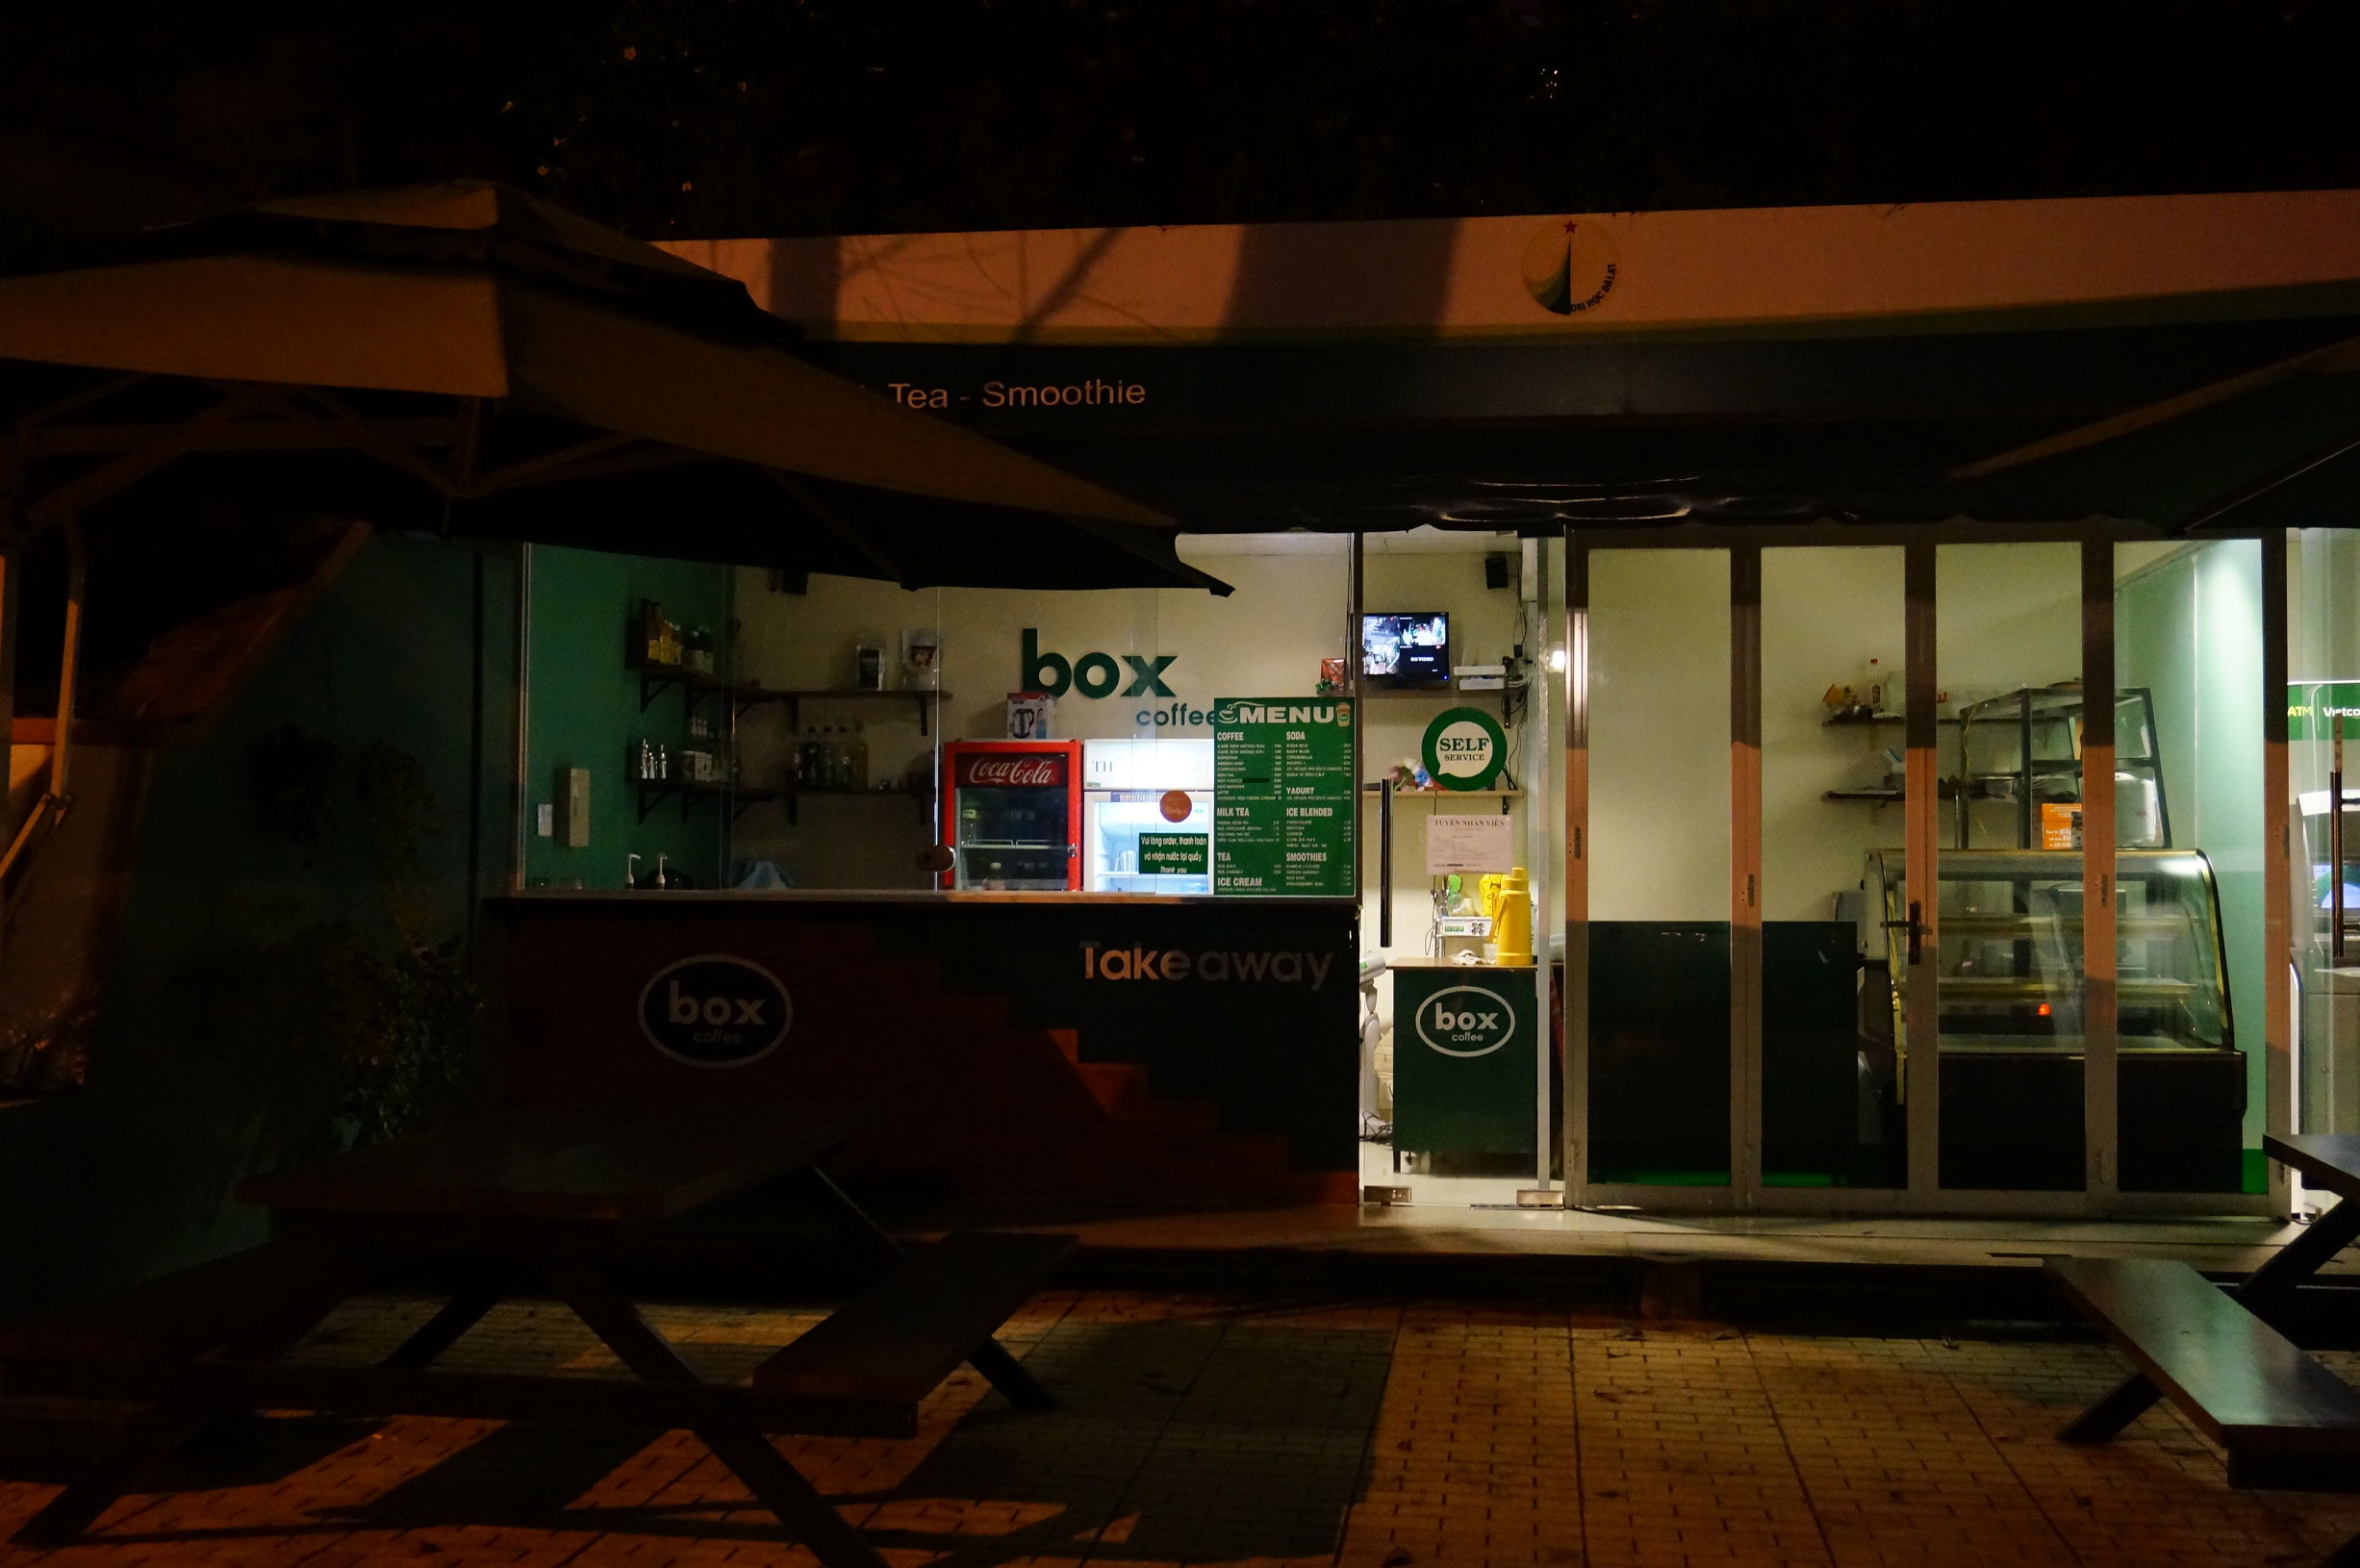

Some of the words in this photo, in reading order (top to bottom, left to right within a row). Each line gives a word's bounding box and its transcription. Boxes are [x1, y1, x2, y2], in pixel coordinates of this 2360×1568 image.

[887, 382, 948, 409] Tea
[981, 378, 1146, 408] Smoothie
[1023, 628, 1178, 699] box
[1239, 706, 1334, 723] MENU
[1217, 732, 1244, 742] COFFEE
[1286, 731, 1305, 741] SODA
[1439, 738, 1490, 751] SELF
[1216, 807, 1234, 817] MILK
[1235, 807, 1250, 817] TEA
[1286, 807, 1298, 817] ICE
[1300, 807, 1333, 817] BLENDED
[1217, 852, 1231, 862] TEA
[1286, 852, 1327, 862] SMOOTHIES
[1217, 877, 1231, 886] ICE
[1233, 877, 1262, 886] CREAM
[1078, 940, 1192, 981] Take
[1198, 949, 1334, 992] away
[669, 979, 768, 1025] box
[1434, 1002, 1499, 1031] box
[693, 1028, 743, 1044] coffee
[1451, 1031, 1484, 1042] coffee
